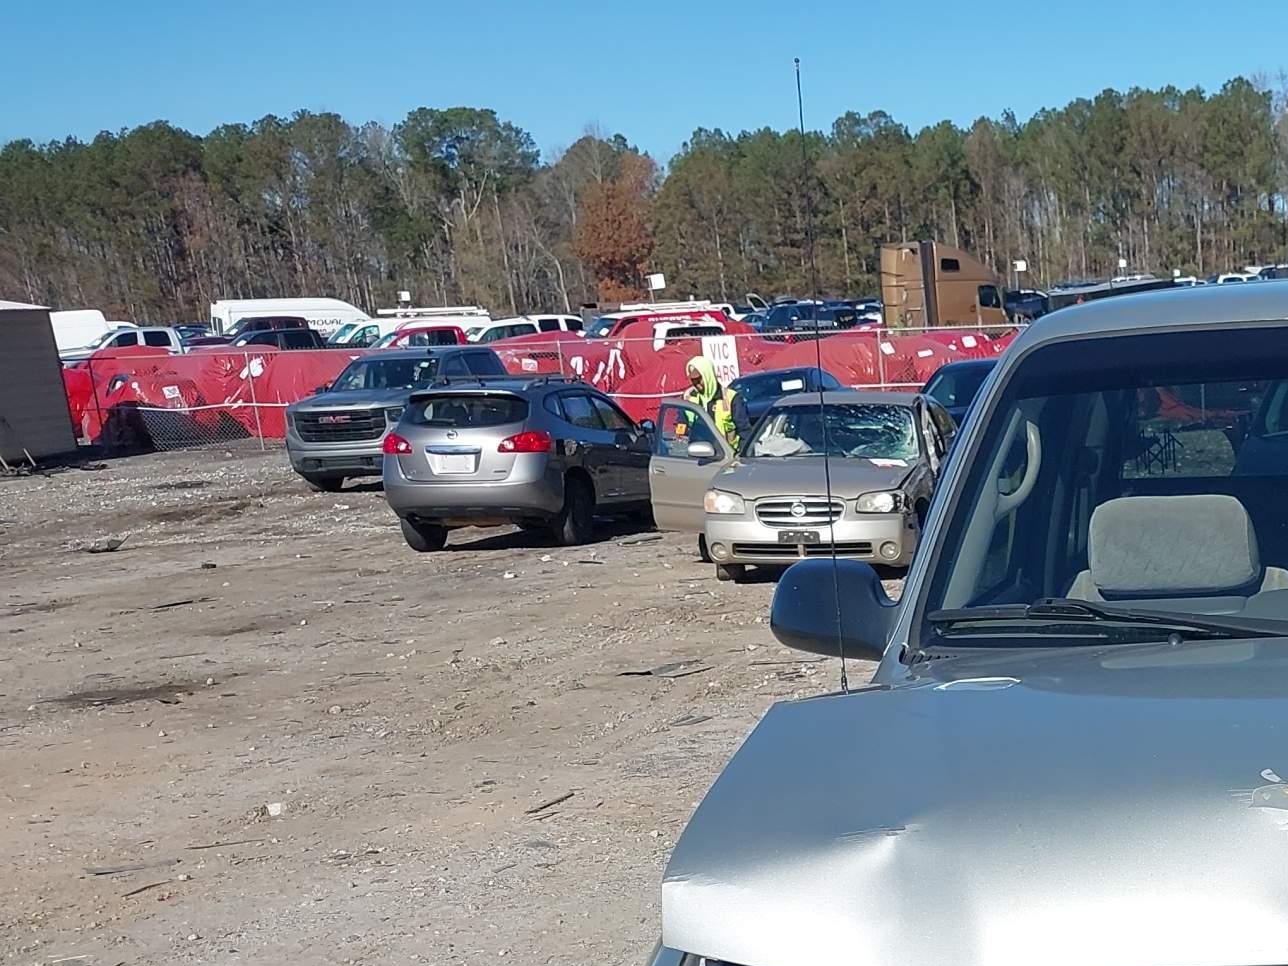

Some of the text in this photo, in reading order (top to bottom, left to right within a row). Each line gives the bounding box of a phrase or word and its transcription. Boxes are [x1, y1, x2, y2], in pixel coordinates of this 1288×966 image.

[709, 342, 729, 360] VIC
[716, 364, 736, 382] ARS
[318, 415, 351, 424] GMC
